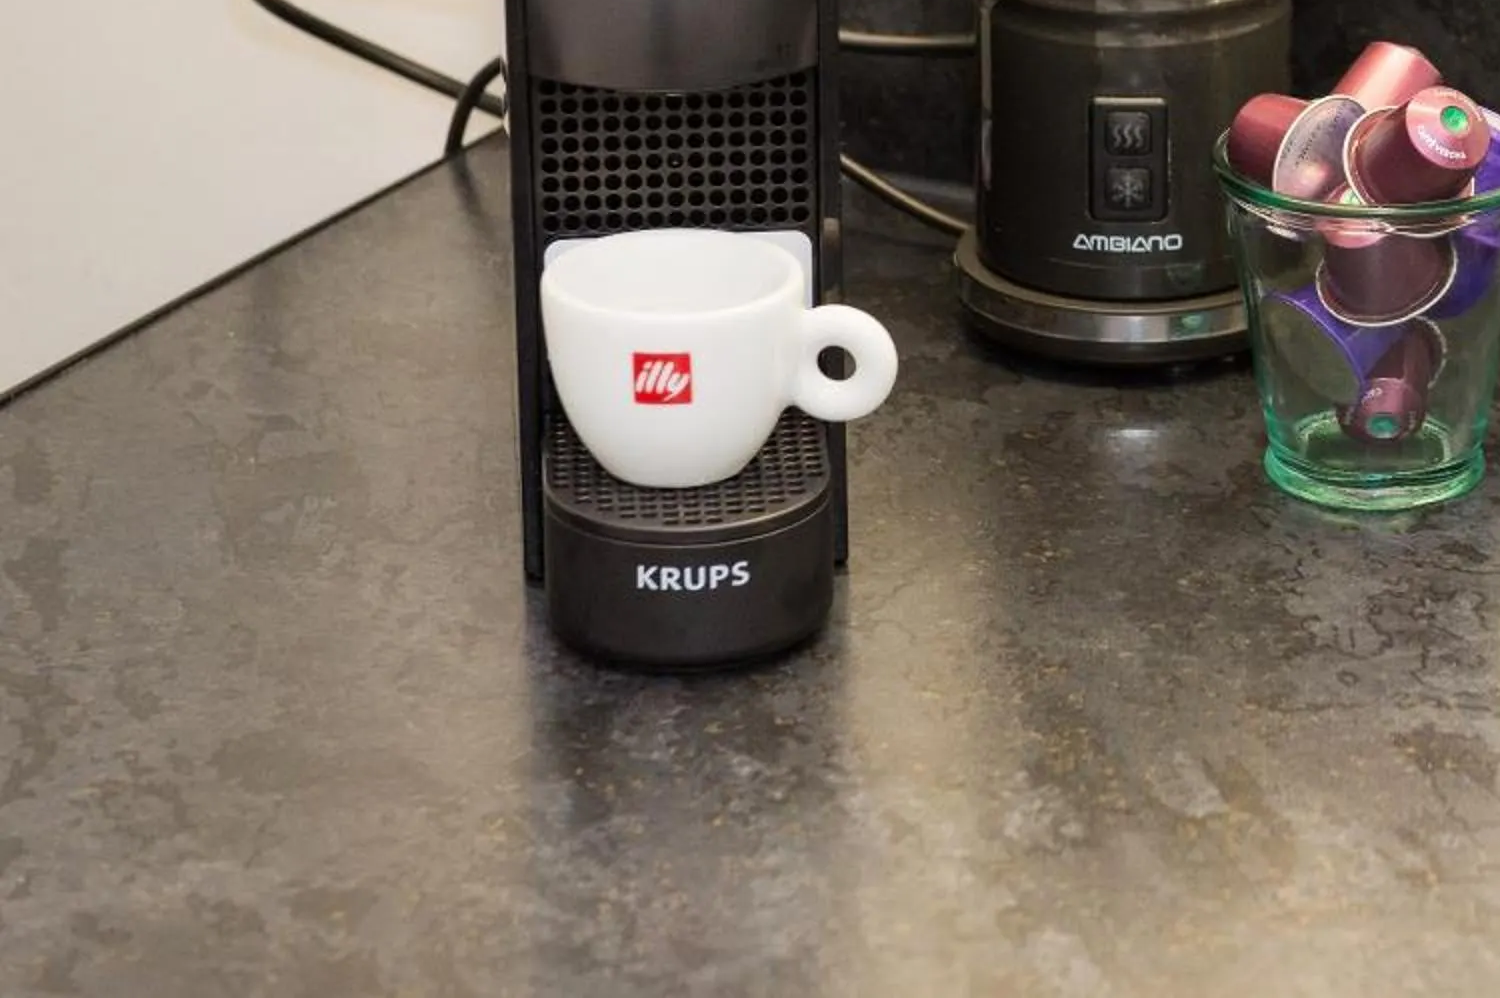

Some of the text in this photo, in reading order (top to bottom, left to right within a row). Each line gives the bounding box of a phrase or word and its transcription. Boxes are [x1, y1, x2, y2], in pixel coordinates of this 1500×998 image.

[1073, 233, 1183, 252] AMBIANO
[635, 360, 690, 401] illy
[636, 561, 750, 591] KRUPS
